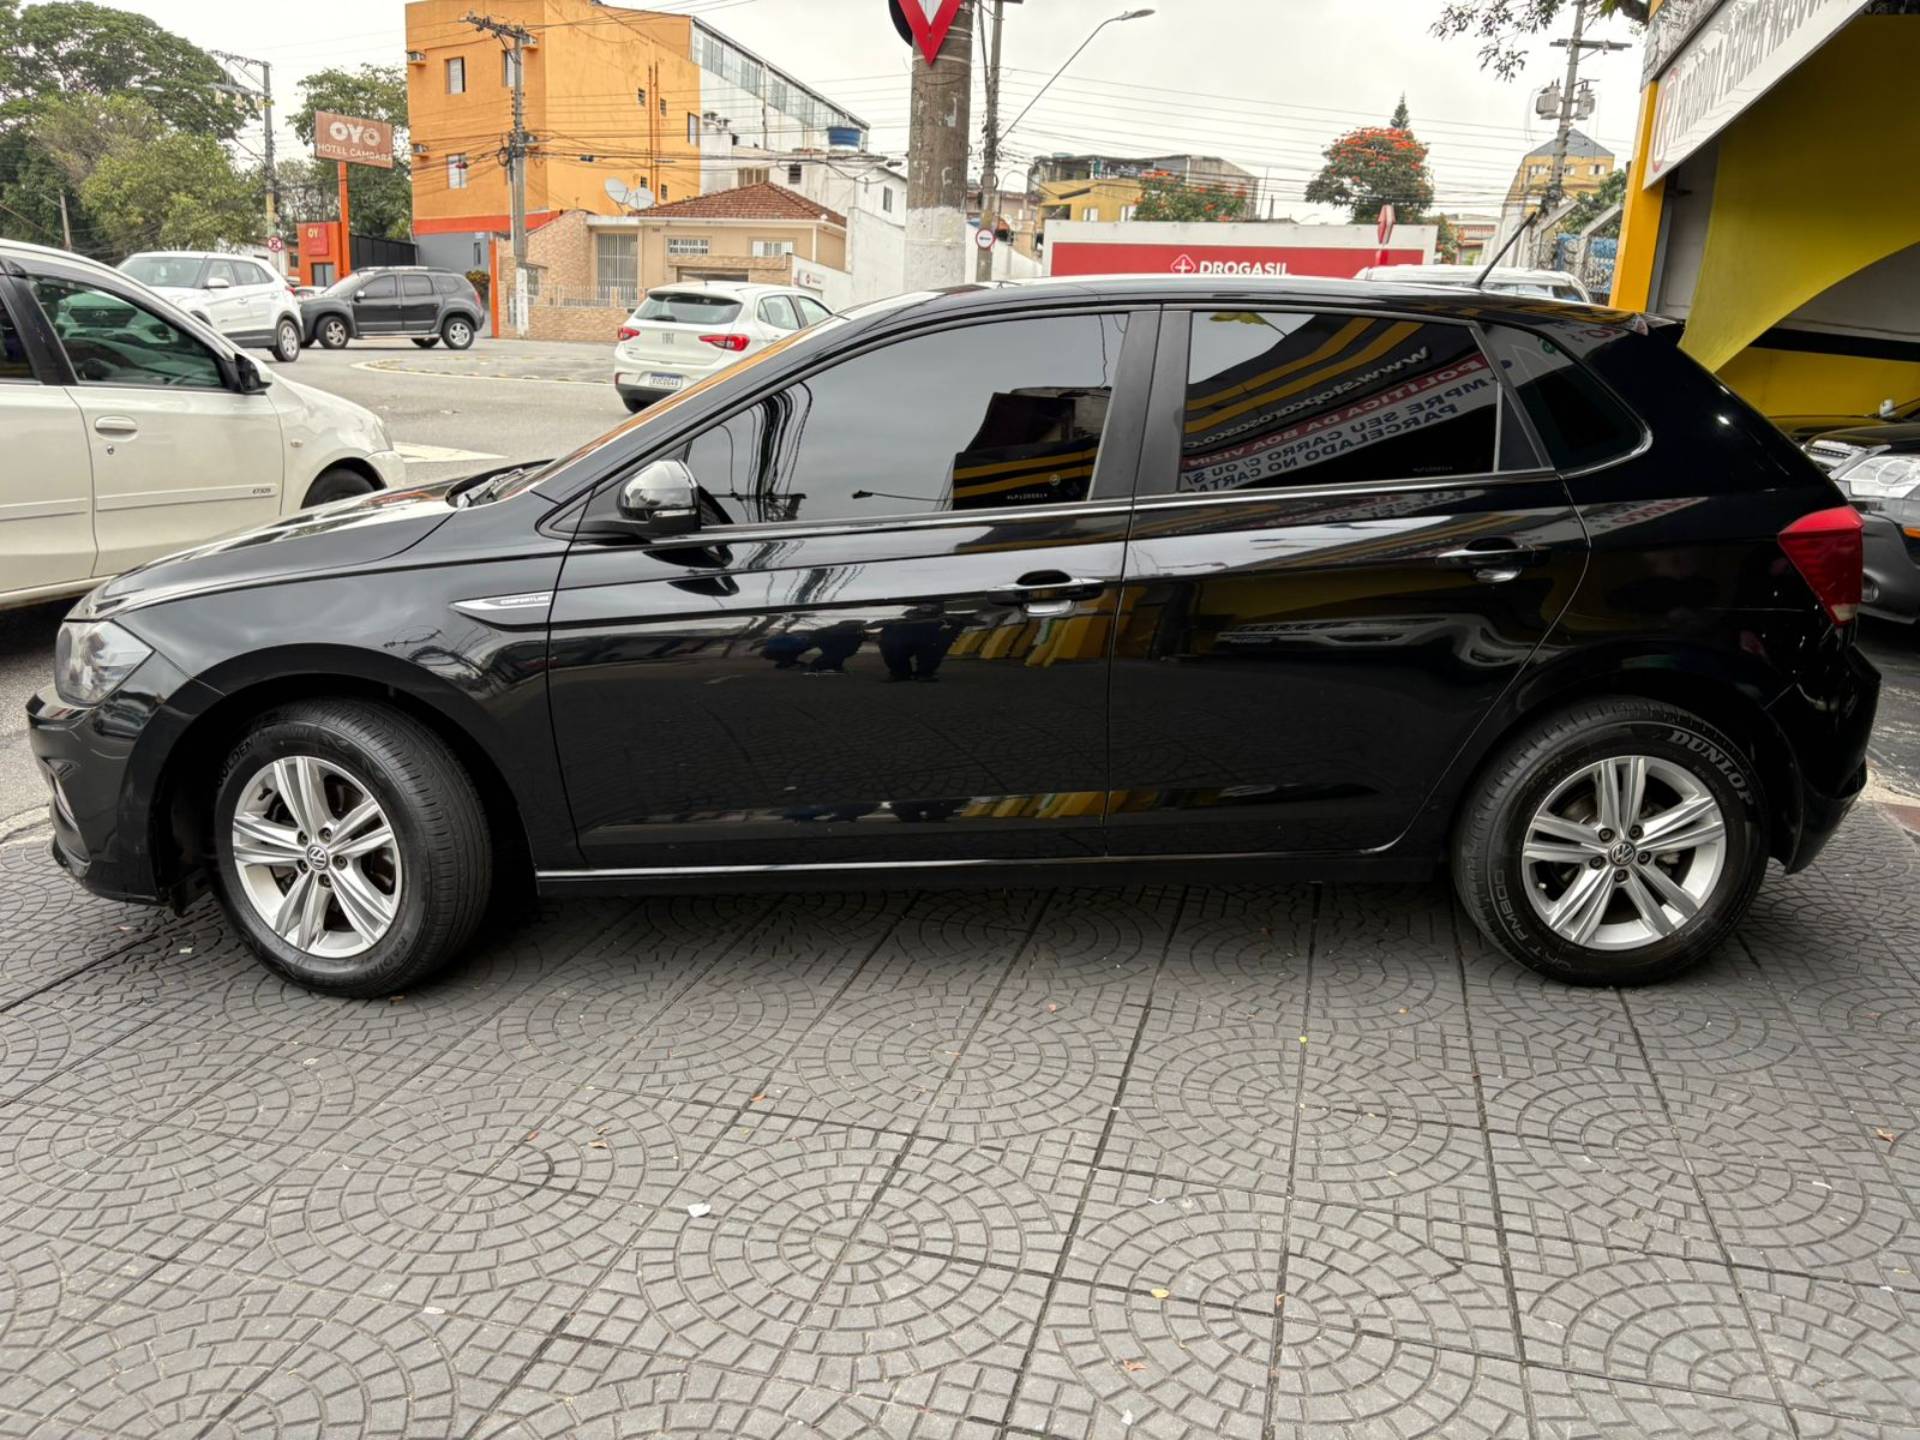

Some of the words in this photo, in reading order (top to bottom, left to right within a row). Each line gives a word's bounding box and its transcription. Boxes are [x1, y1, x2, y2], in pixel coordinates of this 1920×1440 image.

[329, 121, 381, 146] OYO
[317, 143, 347, 156] HOTEL
[1200, 260, 1289, 276] DROGASIL
[1666, 729, 1754, 806] DUNLOP
